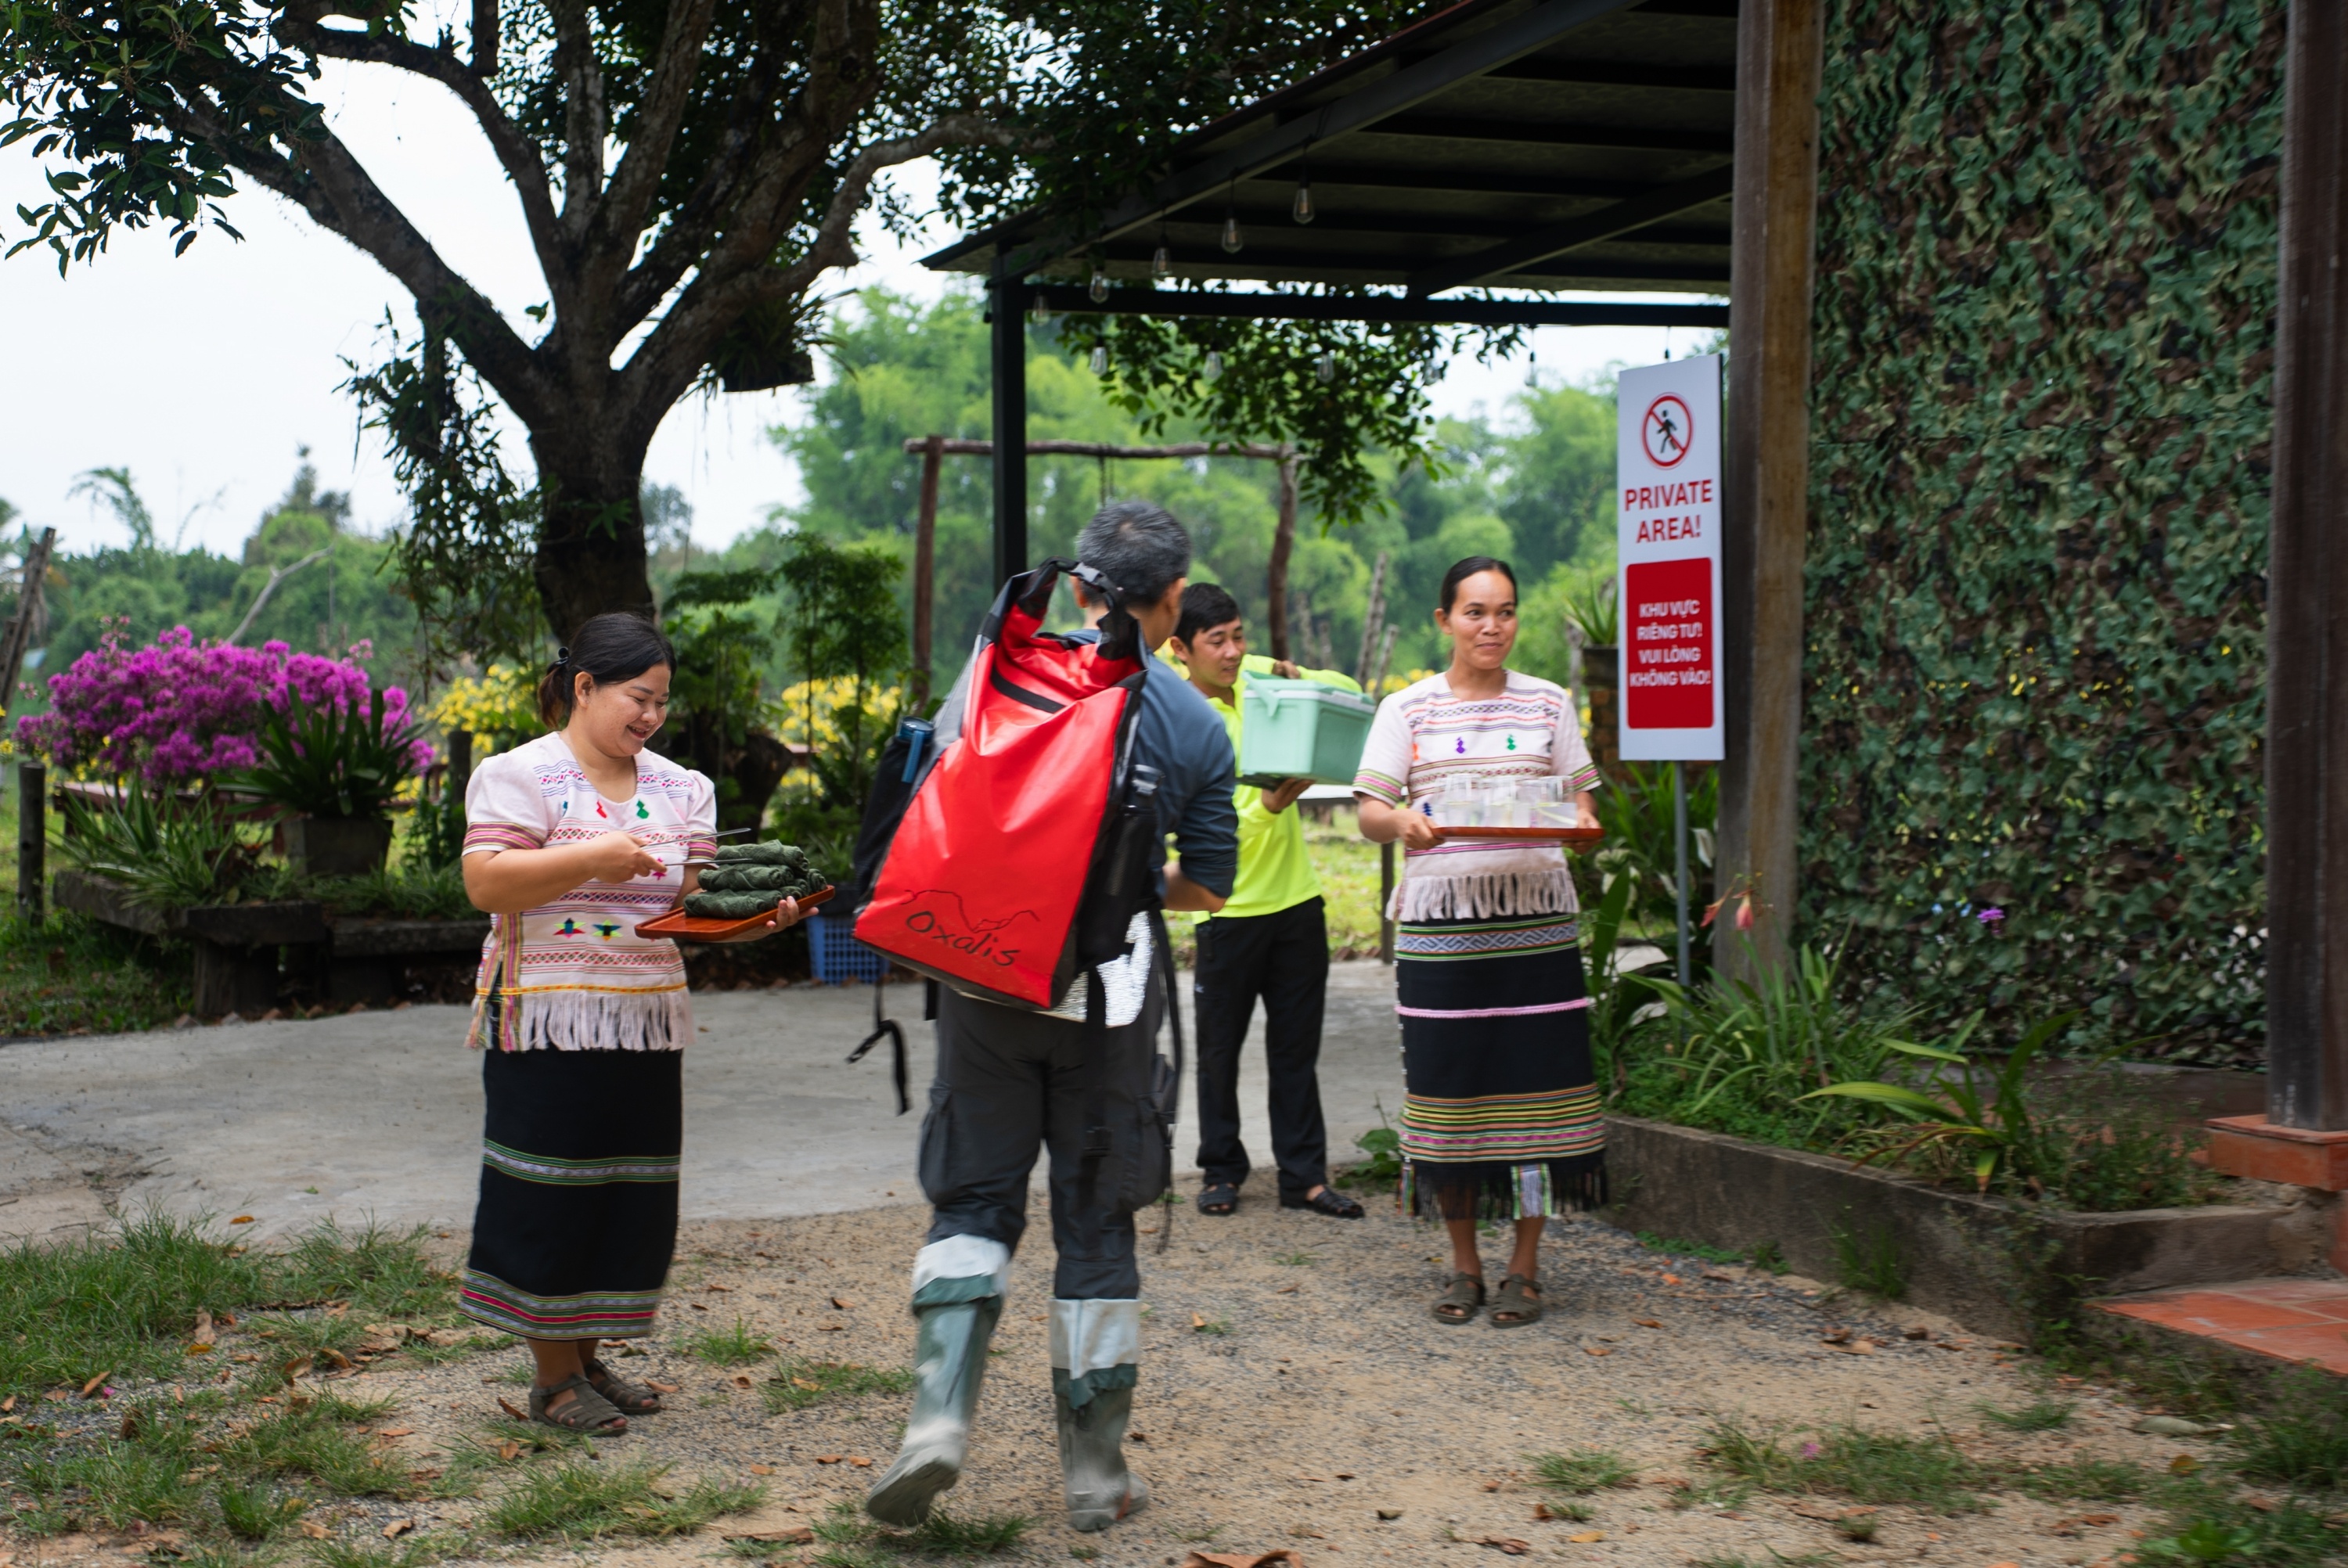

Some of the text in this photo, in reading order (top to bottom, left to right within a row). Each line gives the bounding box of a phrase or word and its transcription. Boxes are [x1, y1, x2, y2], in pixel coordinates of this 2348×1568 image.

[1625, 479, 1712, 512] PRIVATE
[1636, 514, 1701, 543] AREA!
[1639, 599, 1701, 619] KHU VỰC
[1637, 622, 1679, 641] RIÊNG
[1637, 649, 1662, 664] VUI
[1630, 668, 1679, 687] KHÔNG
[906, 911, 1021, 966] Oxalis
